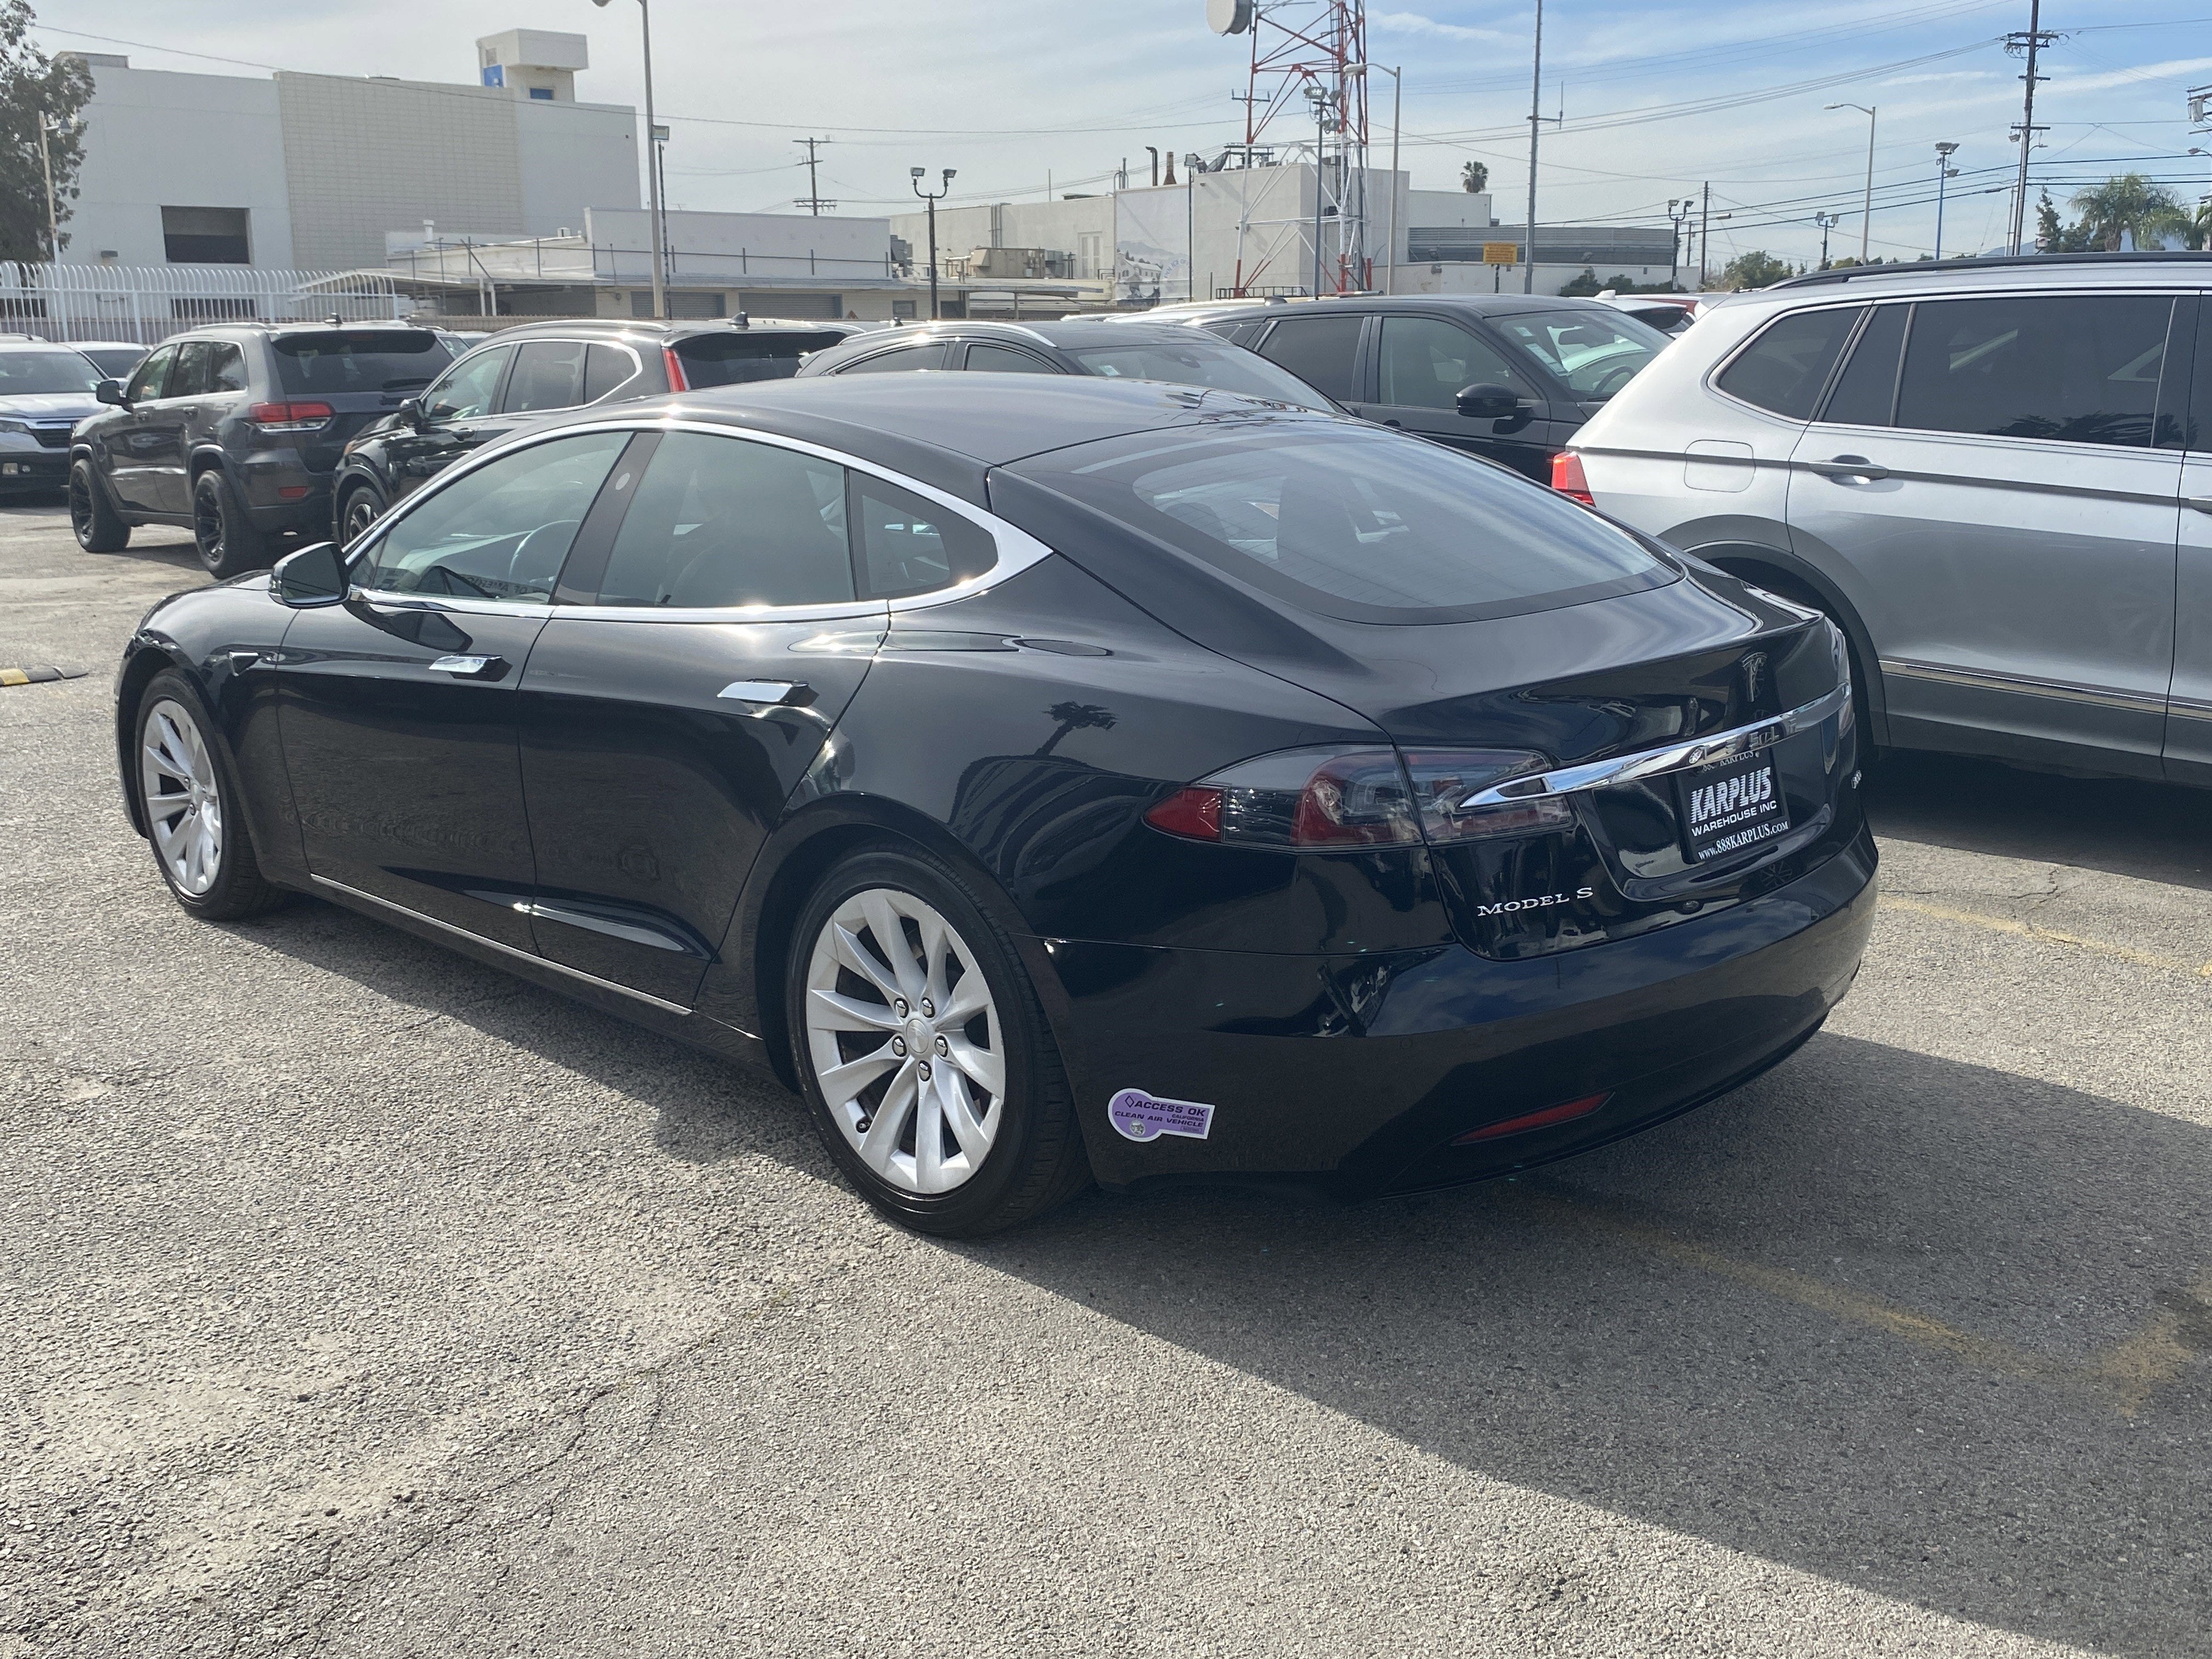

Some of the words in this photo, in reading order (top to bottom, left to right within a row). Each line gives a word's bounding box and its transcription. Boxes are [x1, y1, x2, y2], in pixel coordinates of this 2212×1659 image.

[1690, 766, 1771, 823] KARPLUS
[1691, 806, 1757, 837] WAREHOUSE
[1759, 800, 1777, 814] INC
[1476, 893, 1570, 917] MODEL
[1576, 887, 1594, 899] S
[1114, 1110, 1145, 1120] CLEAN
[1166, 1118, 1204, 1128] VEHICLE
[1134, 1100, 1184, 1113] ACCESS
[1188, 1108, 1206, 1116] OK
[1171, 1113, 1204, 1122] CALIFORNIA
